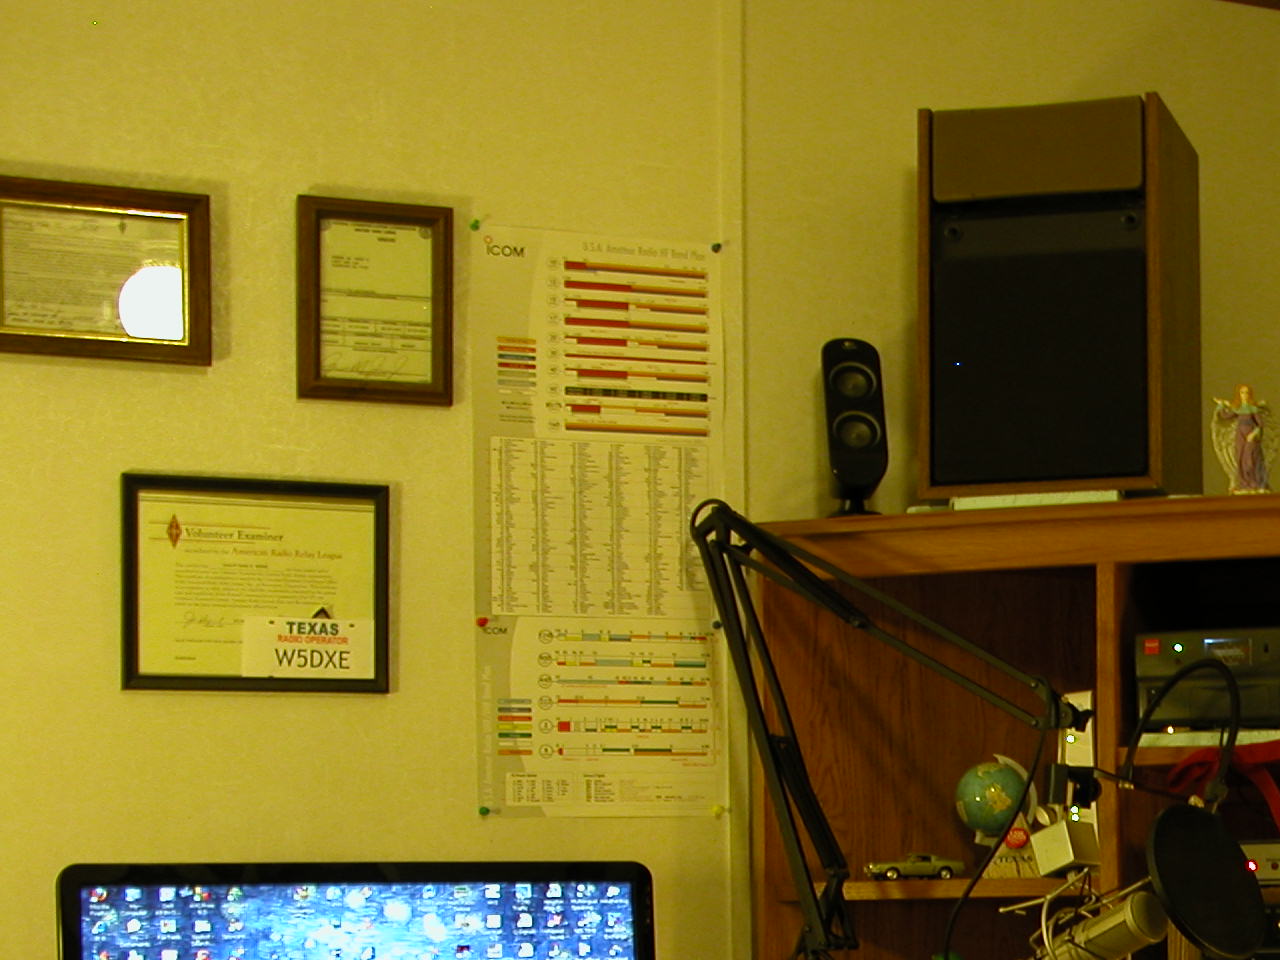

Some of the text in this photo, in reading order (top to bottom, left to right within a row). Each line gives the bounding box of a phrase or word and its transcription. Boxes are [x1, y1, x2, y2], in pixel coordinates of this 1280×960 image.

[185, 527, 284, 542] Volunteer Examiner
[286, 621, 339, 636] TEXAS
[277, 634, 349, 646] RADIO OPERATOR
[275, 648, 351, 669] W5DXE
